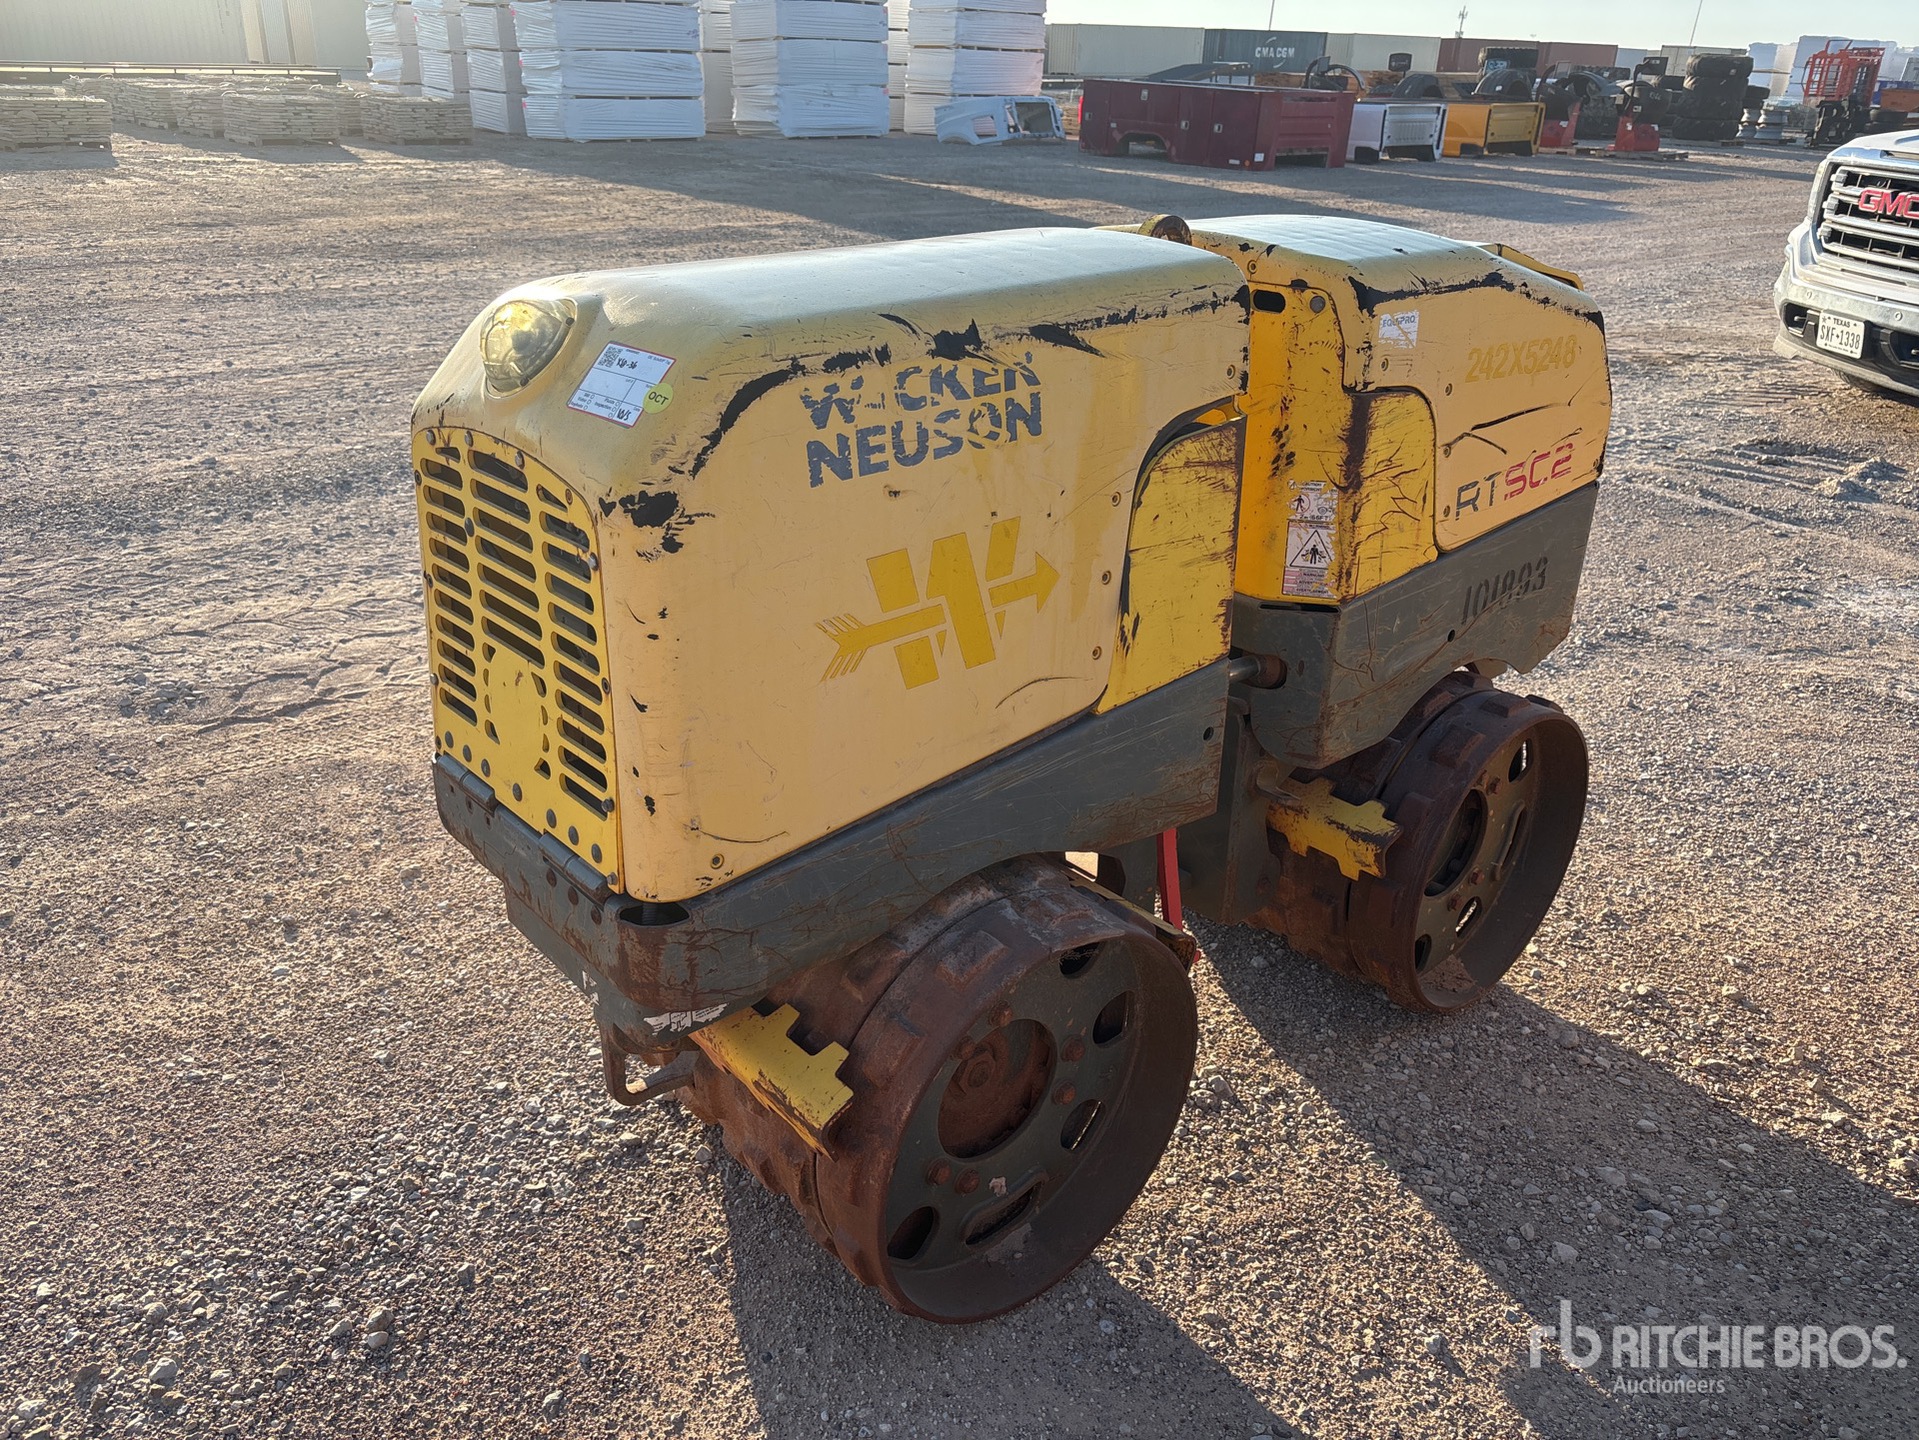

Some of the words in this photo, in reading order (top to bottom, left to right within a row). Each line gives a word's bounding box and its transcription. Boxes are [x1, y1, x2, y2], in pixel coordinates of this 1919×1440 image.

[1254, 46, 1275, 58] CMA
[1276, 47, 1295, 58] CGM
[1859, 188, 1919, 220] GMC
[1833, 317, 1851, 328] TEXAS
[1465, 334, 1578, 383] 242X5248
[649, 391, 669, 405] OCT
[806, 391, 1042, 488] NEUSON
